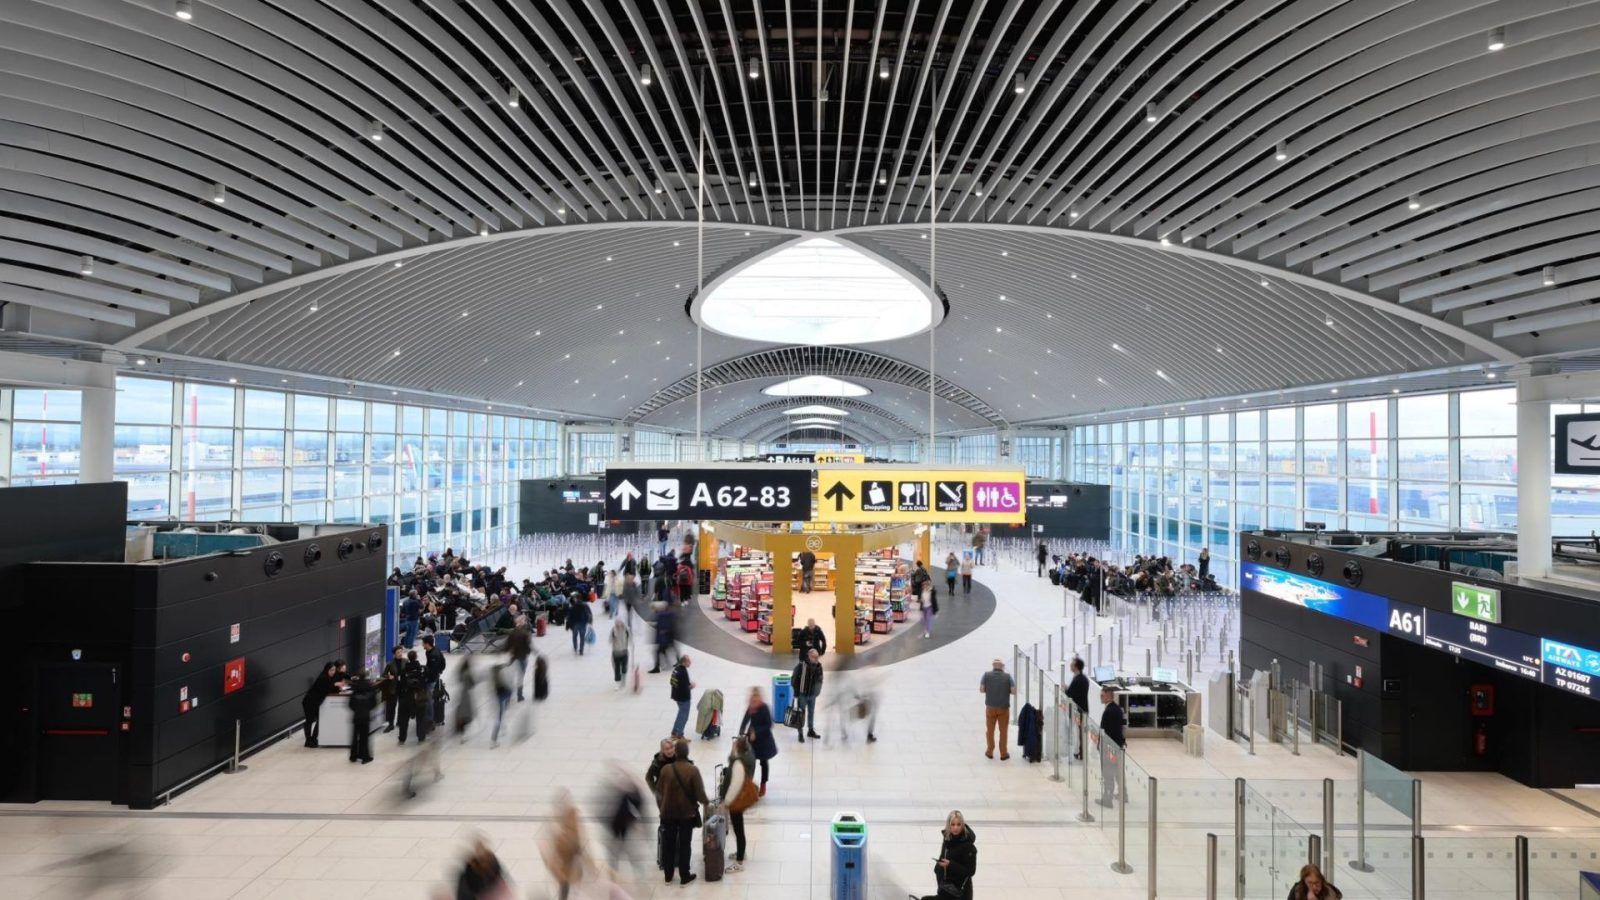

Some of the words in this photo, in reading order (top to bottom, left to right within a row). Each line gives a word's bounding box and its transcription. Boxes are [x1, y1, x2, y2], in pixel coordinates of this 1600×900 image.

[863, 504, 891, 512] Shopping
[939, 501, 964, 509] Smoking
[1389, 609, 1421, 636] A61
[1469, 621, 1488, 633] BARI
[1545, 642, 1582, 661] ITA
[1548, 654, 1581, 668] AIRWAYS
[1555, 667, 1567, 677] AZ
[1555, 677, 1567, 687] TP
[1566, 681, 1591, 695] 07236
